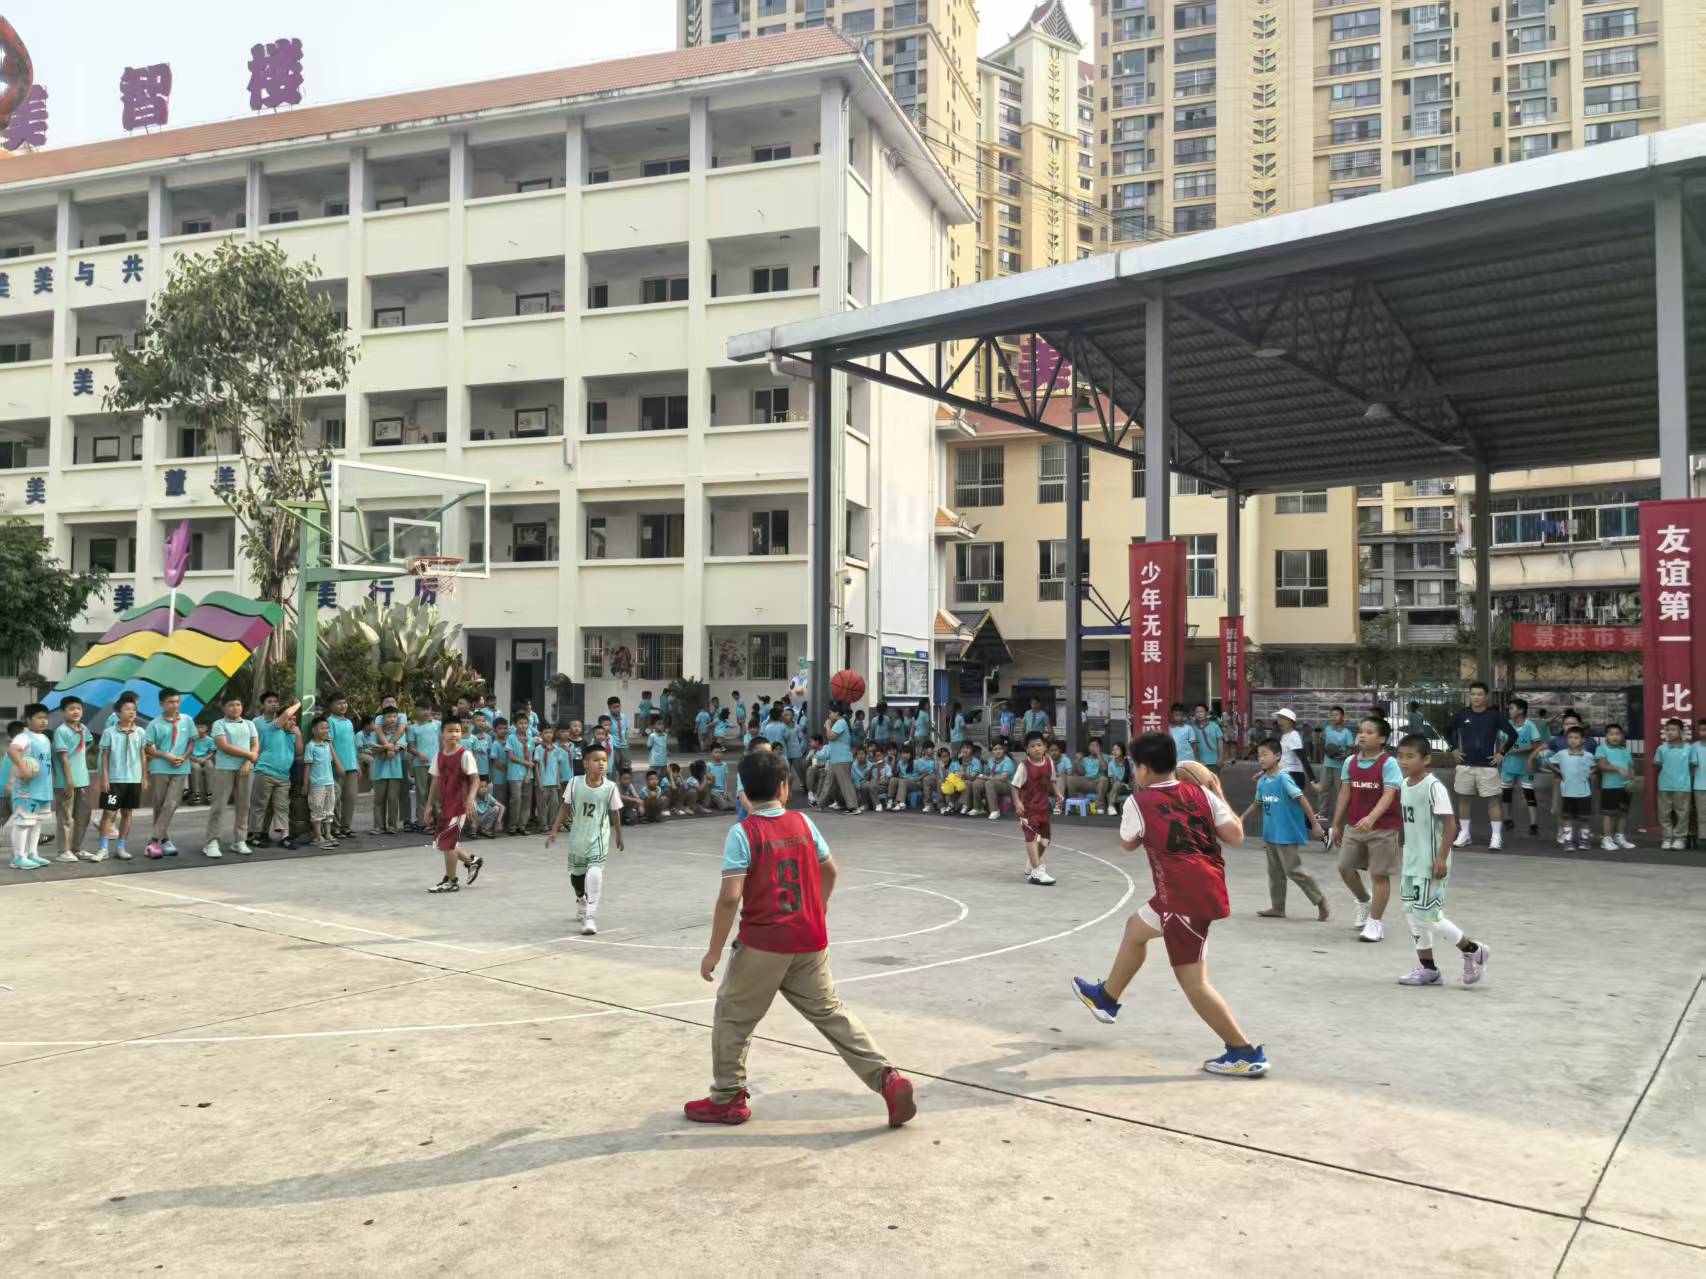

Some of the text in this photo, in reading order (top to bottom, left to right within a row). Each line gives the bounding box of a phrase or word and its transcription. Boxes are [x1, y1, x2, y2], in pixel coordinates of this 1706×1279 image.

[73, 368, 94, 397] 美
[26, 477, 46, 505] 美
[1657, 525, 1691, 642] 友谊第一
[1141, 561, 1162, 663] 少年无畏
[107, 794, 118, 805] 16
[582, 802, 596, 818] 12
[1402, 805, 1415, 823] 13
